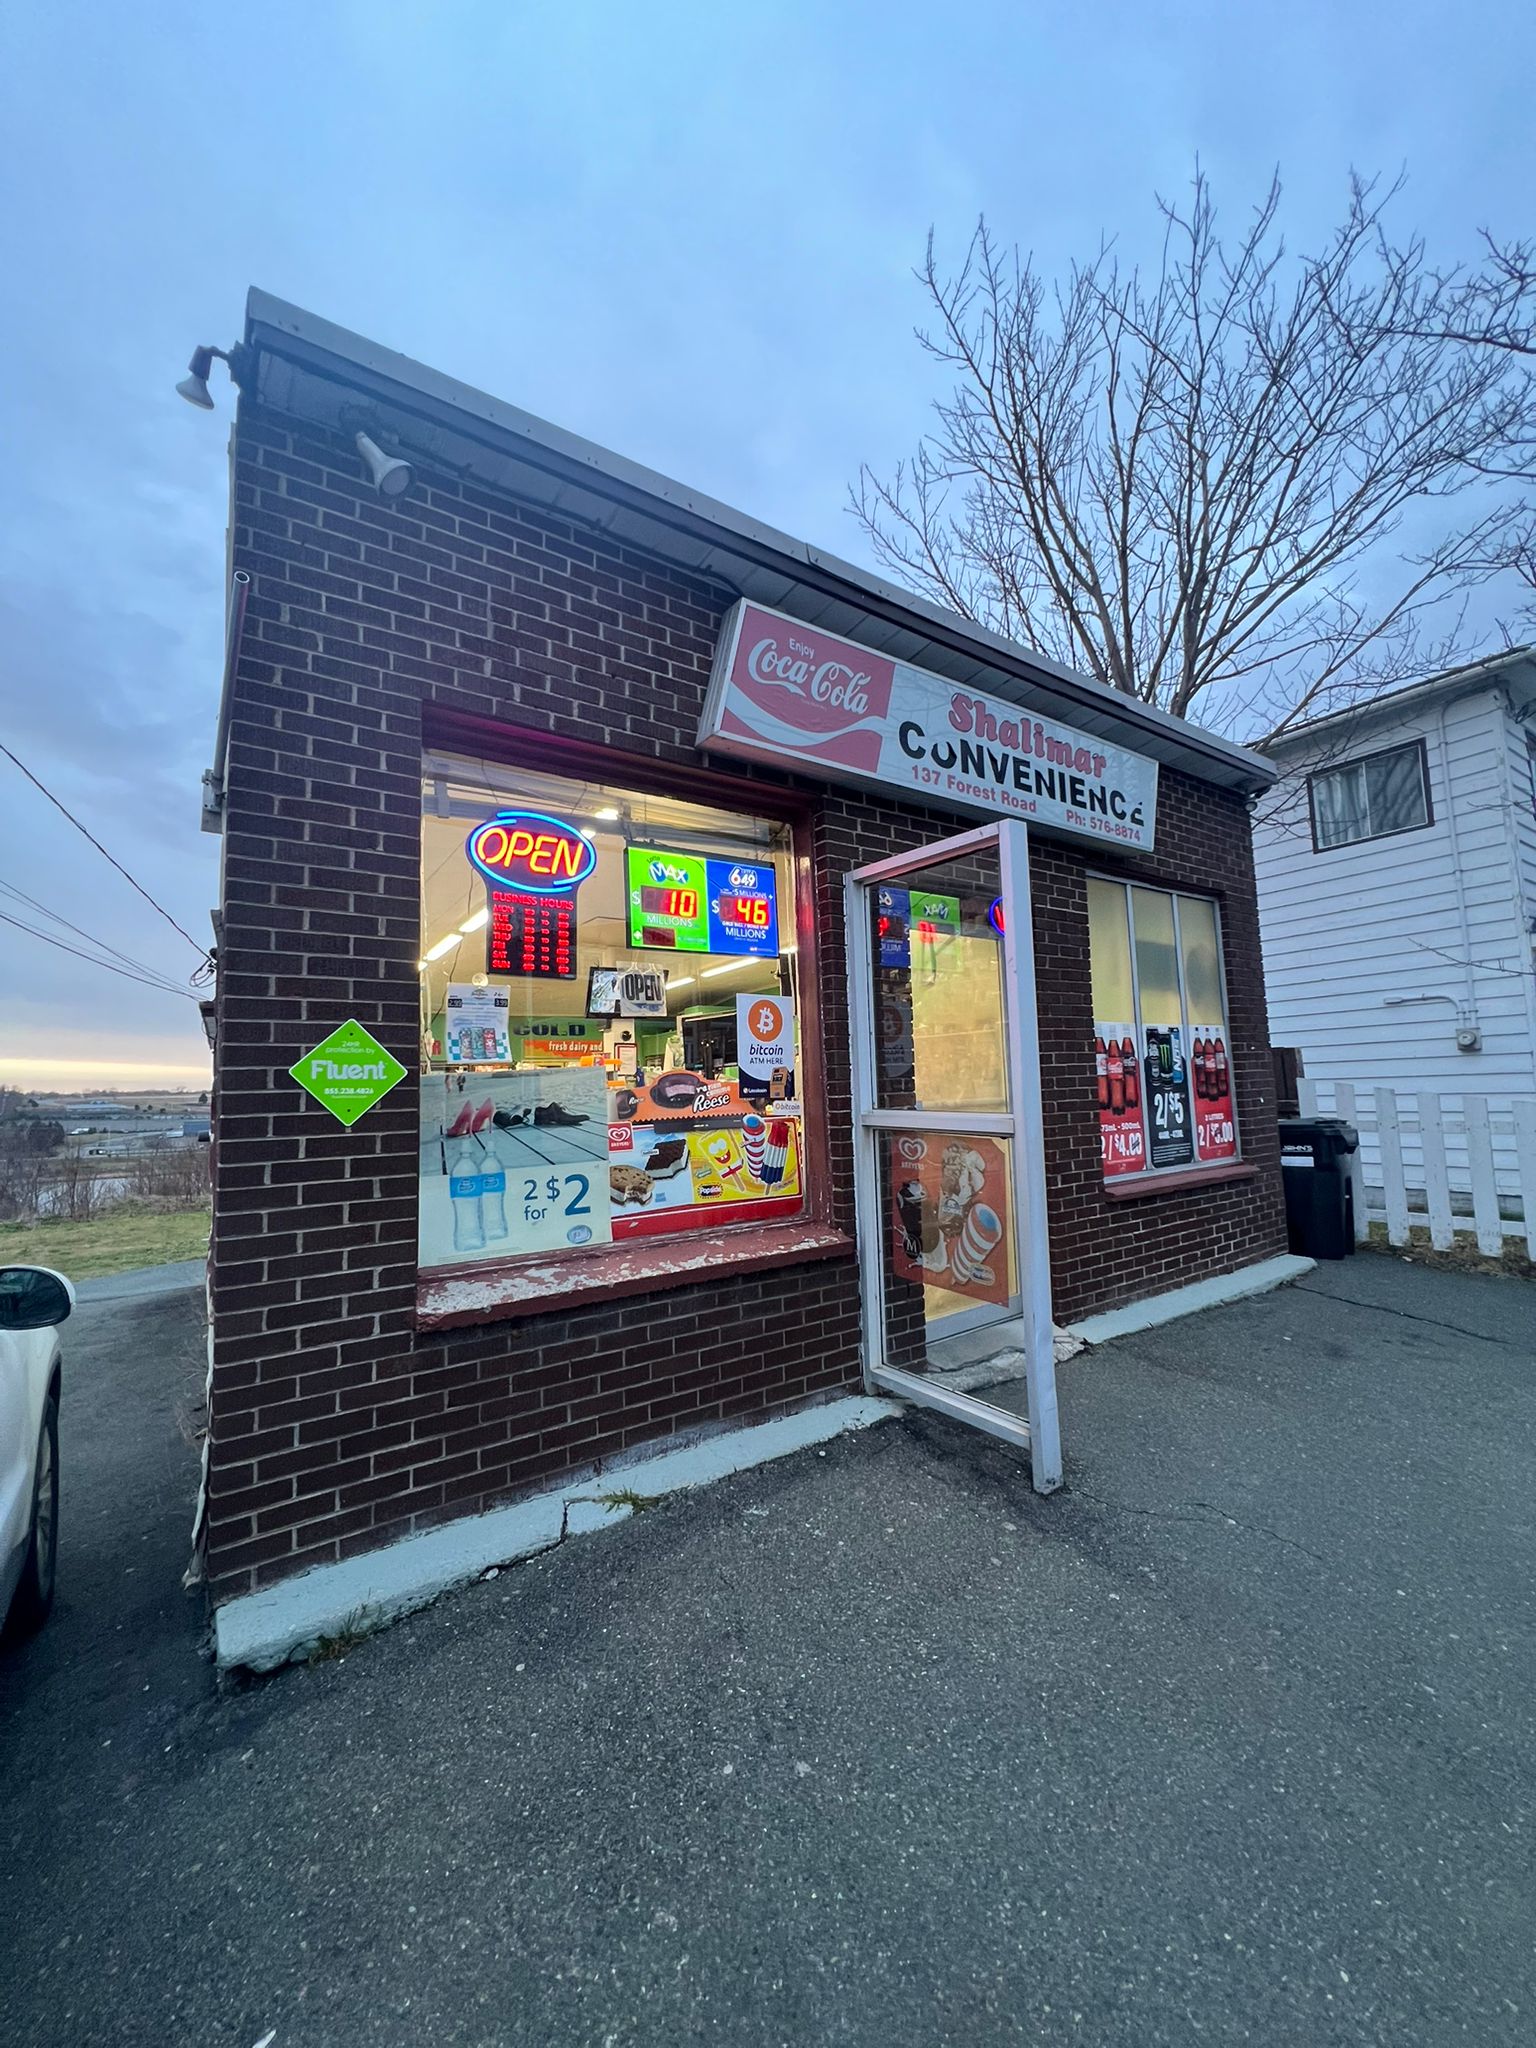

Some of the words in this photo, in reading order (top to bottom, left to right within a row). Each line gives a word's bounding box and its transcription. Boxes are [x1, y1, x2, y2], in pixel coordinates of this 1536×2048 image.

[789, 638, 815, 659] Enjoy
[747, 638, 872, 714] Coca-Cola
[948, 692, 1107, 778] Shalimar
[912, 765, 941, 785] 137
[947, 774, 997, 802] Forest
[1001, 790, 1037, 813] Road
[1066, 809, 1086, 827] Ph:
[1090, 818, 1141, 842] 576-8874
[477, 827, 584, 877] OPEN
[650, 862, 689, 884] MAX
[492, 891, 538, 906] BUSINESS
[540, 897, 574, 911] HOURS
[492, 904, 514, 914] MON
[669, 891, 695, 917] 10
[737, 898, 767, 925] 46
[647, 915, 692, 928] MILLIONS
[725, 927, 767, 940] MILLIONS
[624, 973, 662, 1001] OPEN
[549, 1041, 568, 1051] fresh
[569, 1041, 588, 1053] dairy
[589, 1041, 603, 1051] and
[749, 1044, 784, 1057] bitcoin
[311, 1059, 387, 1080] Fluent
[749, 1057, 764, 1065] ATM
[766, 1057, 784, 1065] HERE
[693, 1094, 730, 1113] Reese
[781, 1102, 800, 1111] bitcoin
[524, 1179, 538, 1201] 2
[546, 1173, 591, 1217] $2
[524, 1205, 548, 1221] for
